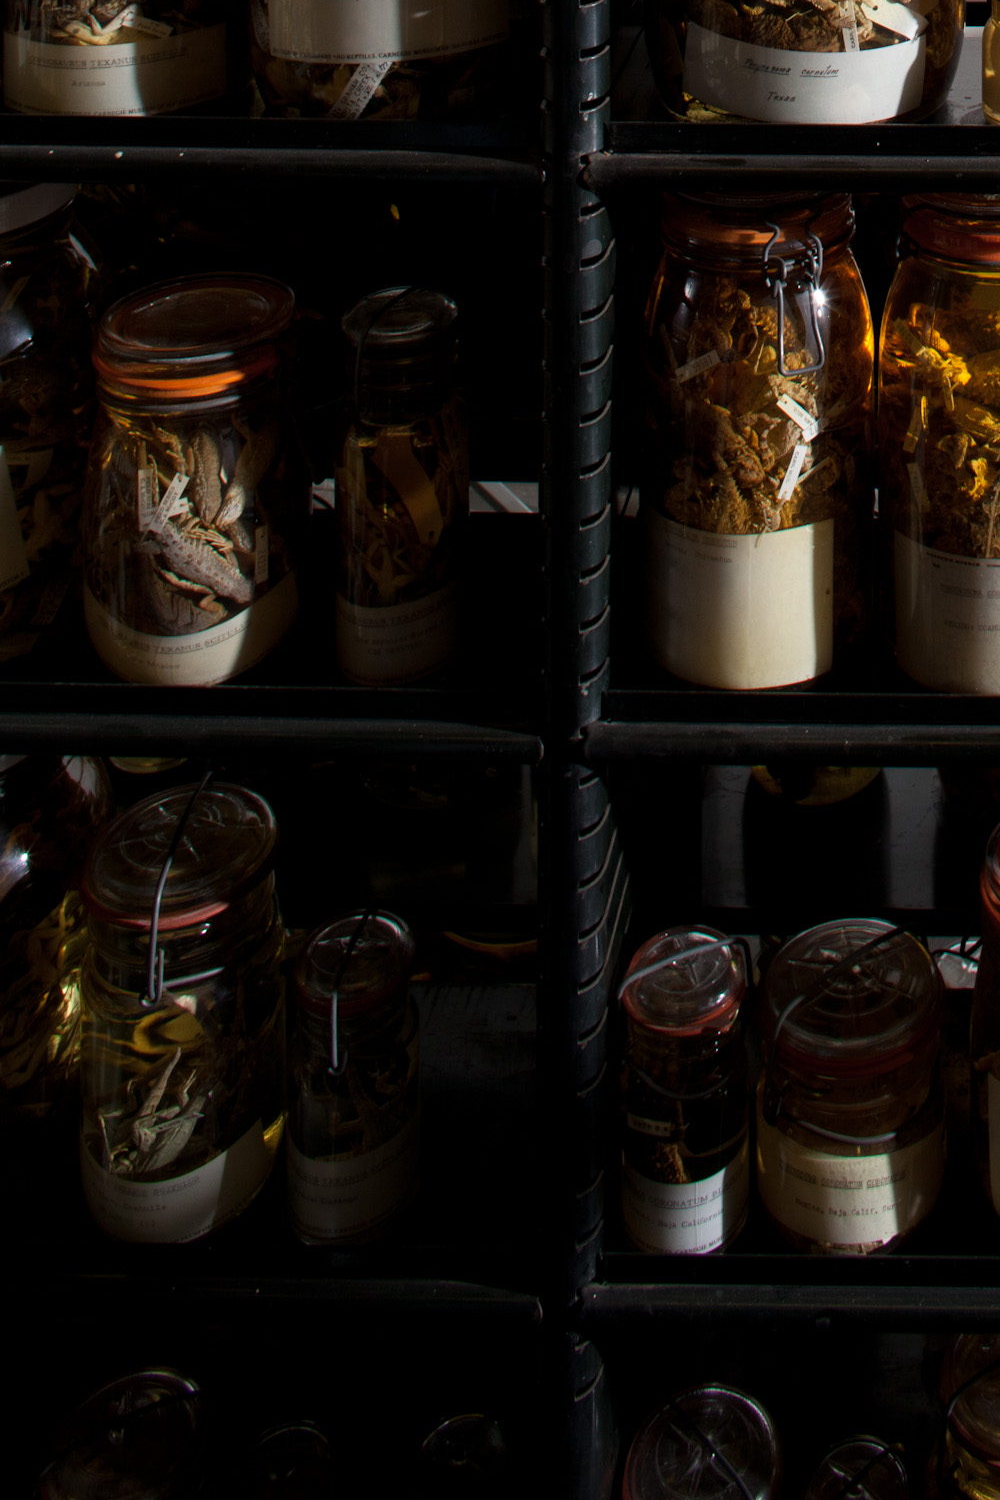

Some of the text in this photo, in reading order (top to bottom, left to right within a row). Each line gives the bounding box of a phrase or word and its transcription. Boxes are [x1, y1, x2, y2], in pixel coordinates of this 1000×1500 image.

[90, 55, 137, 68] TEXANUS
[71, 79, 106, 88] Arizona
[768, 91, 797, 102] Texas
[155, 641, 202, 654] TEXANUS
[649, 1194, 709, 1210] CORONATUM
[658, 1219, 677, 1229] Baja
